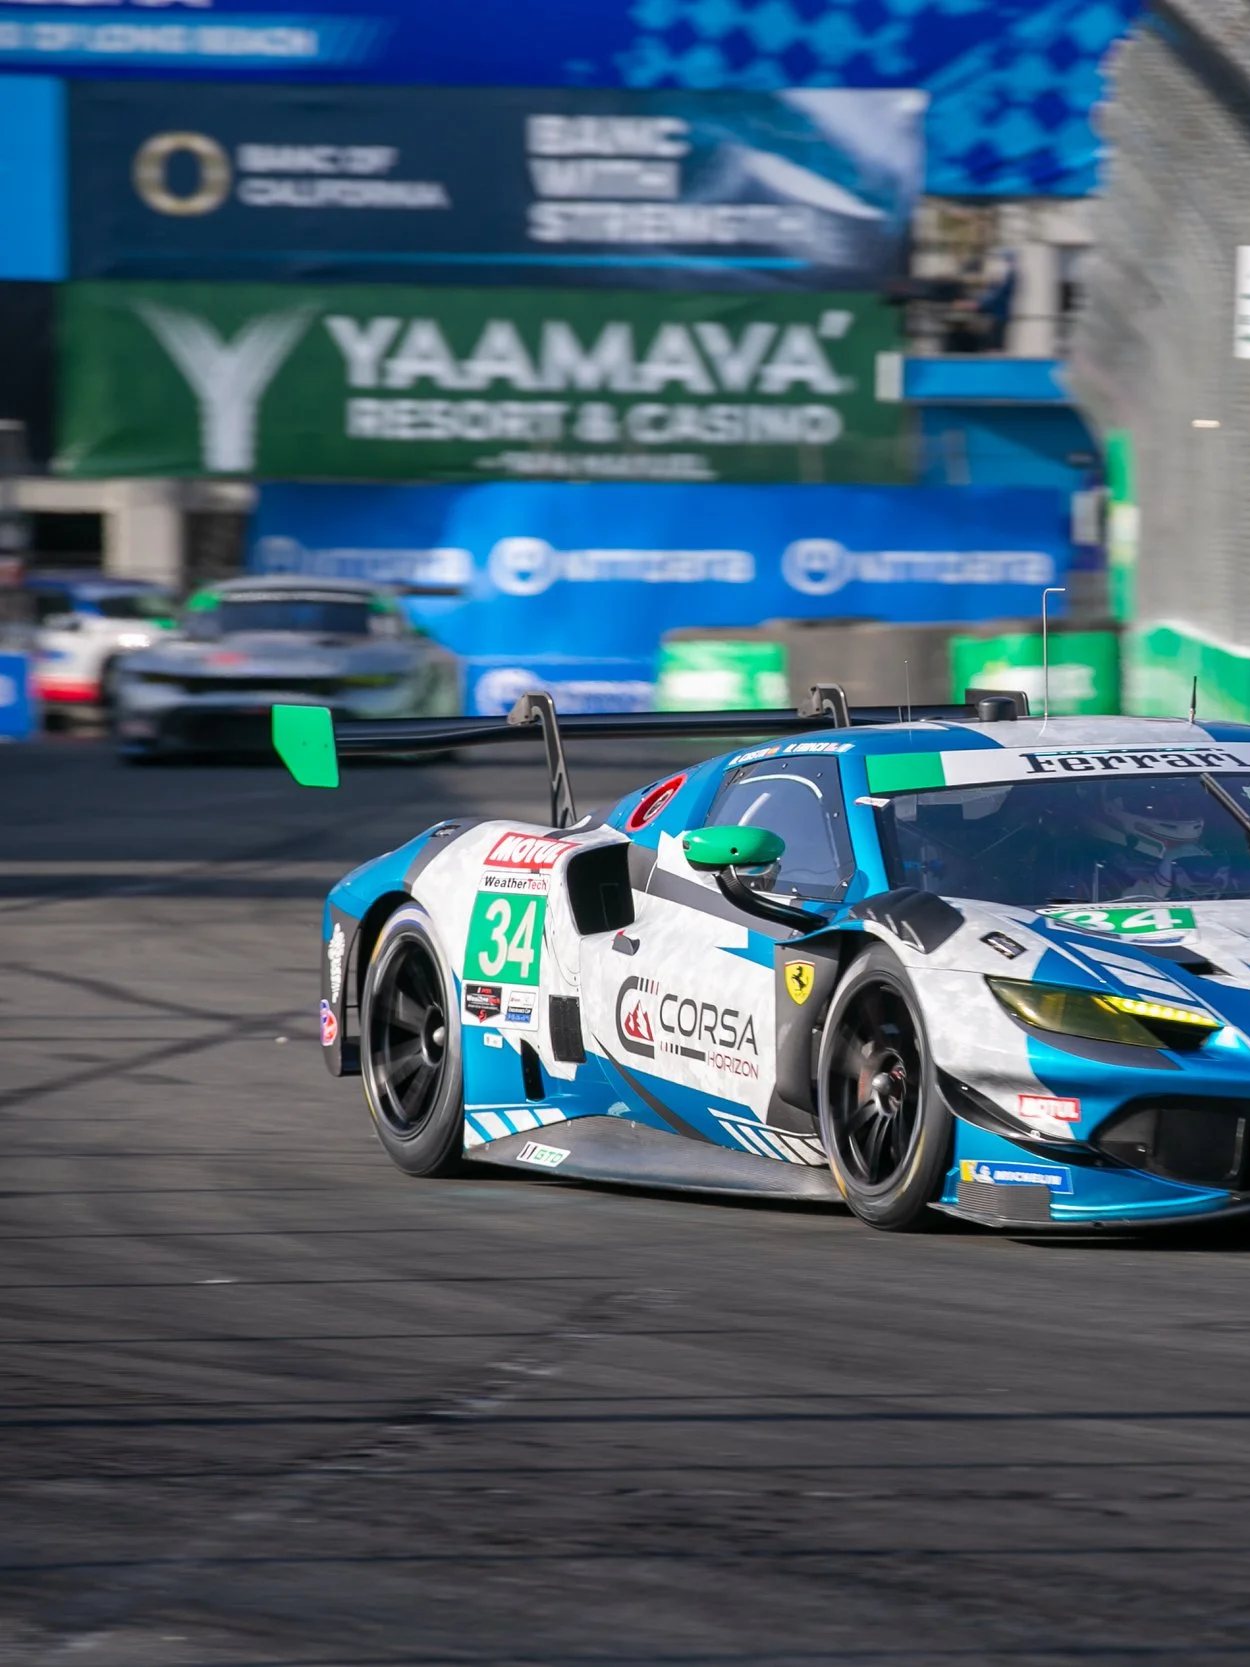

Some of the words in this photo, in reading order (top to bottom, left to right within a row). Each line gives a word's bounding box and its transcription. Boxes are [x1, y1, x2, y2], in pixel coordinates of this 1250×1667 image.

[346, 398, 568, 440] RESORT
[573, 402, 616, 443] &
[625, 405, 843, 444] CASINO
[489, 835, 572, 864] MOTUL
[484, 875, 548, 891] WeatherTech
[1058, 908, 1183, 931] 34
[478, 898, 537, 978] 34
[659, 993, 759, 1057] CORSA
[706, 1050, 759, 1081] HORIZON
[1021, 1097, 1079, 1119] MOTUL
[533, 1149, 563, 1164] GTD
